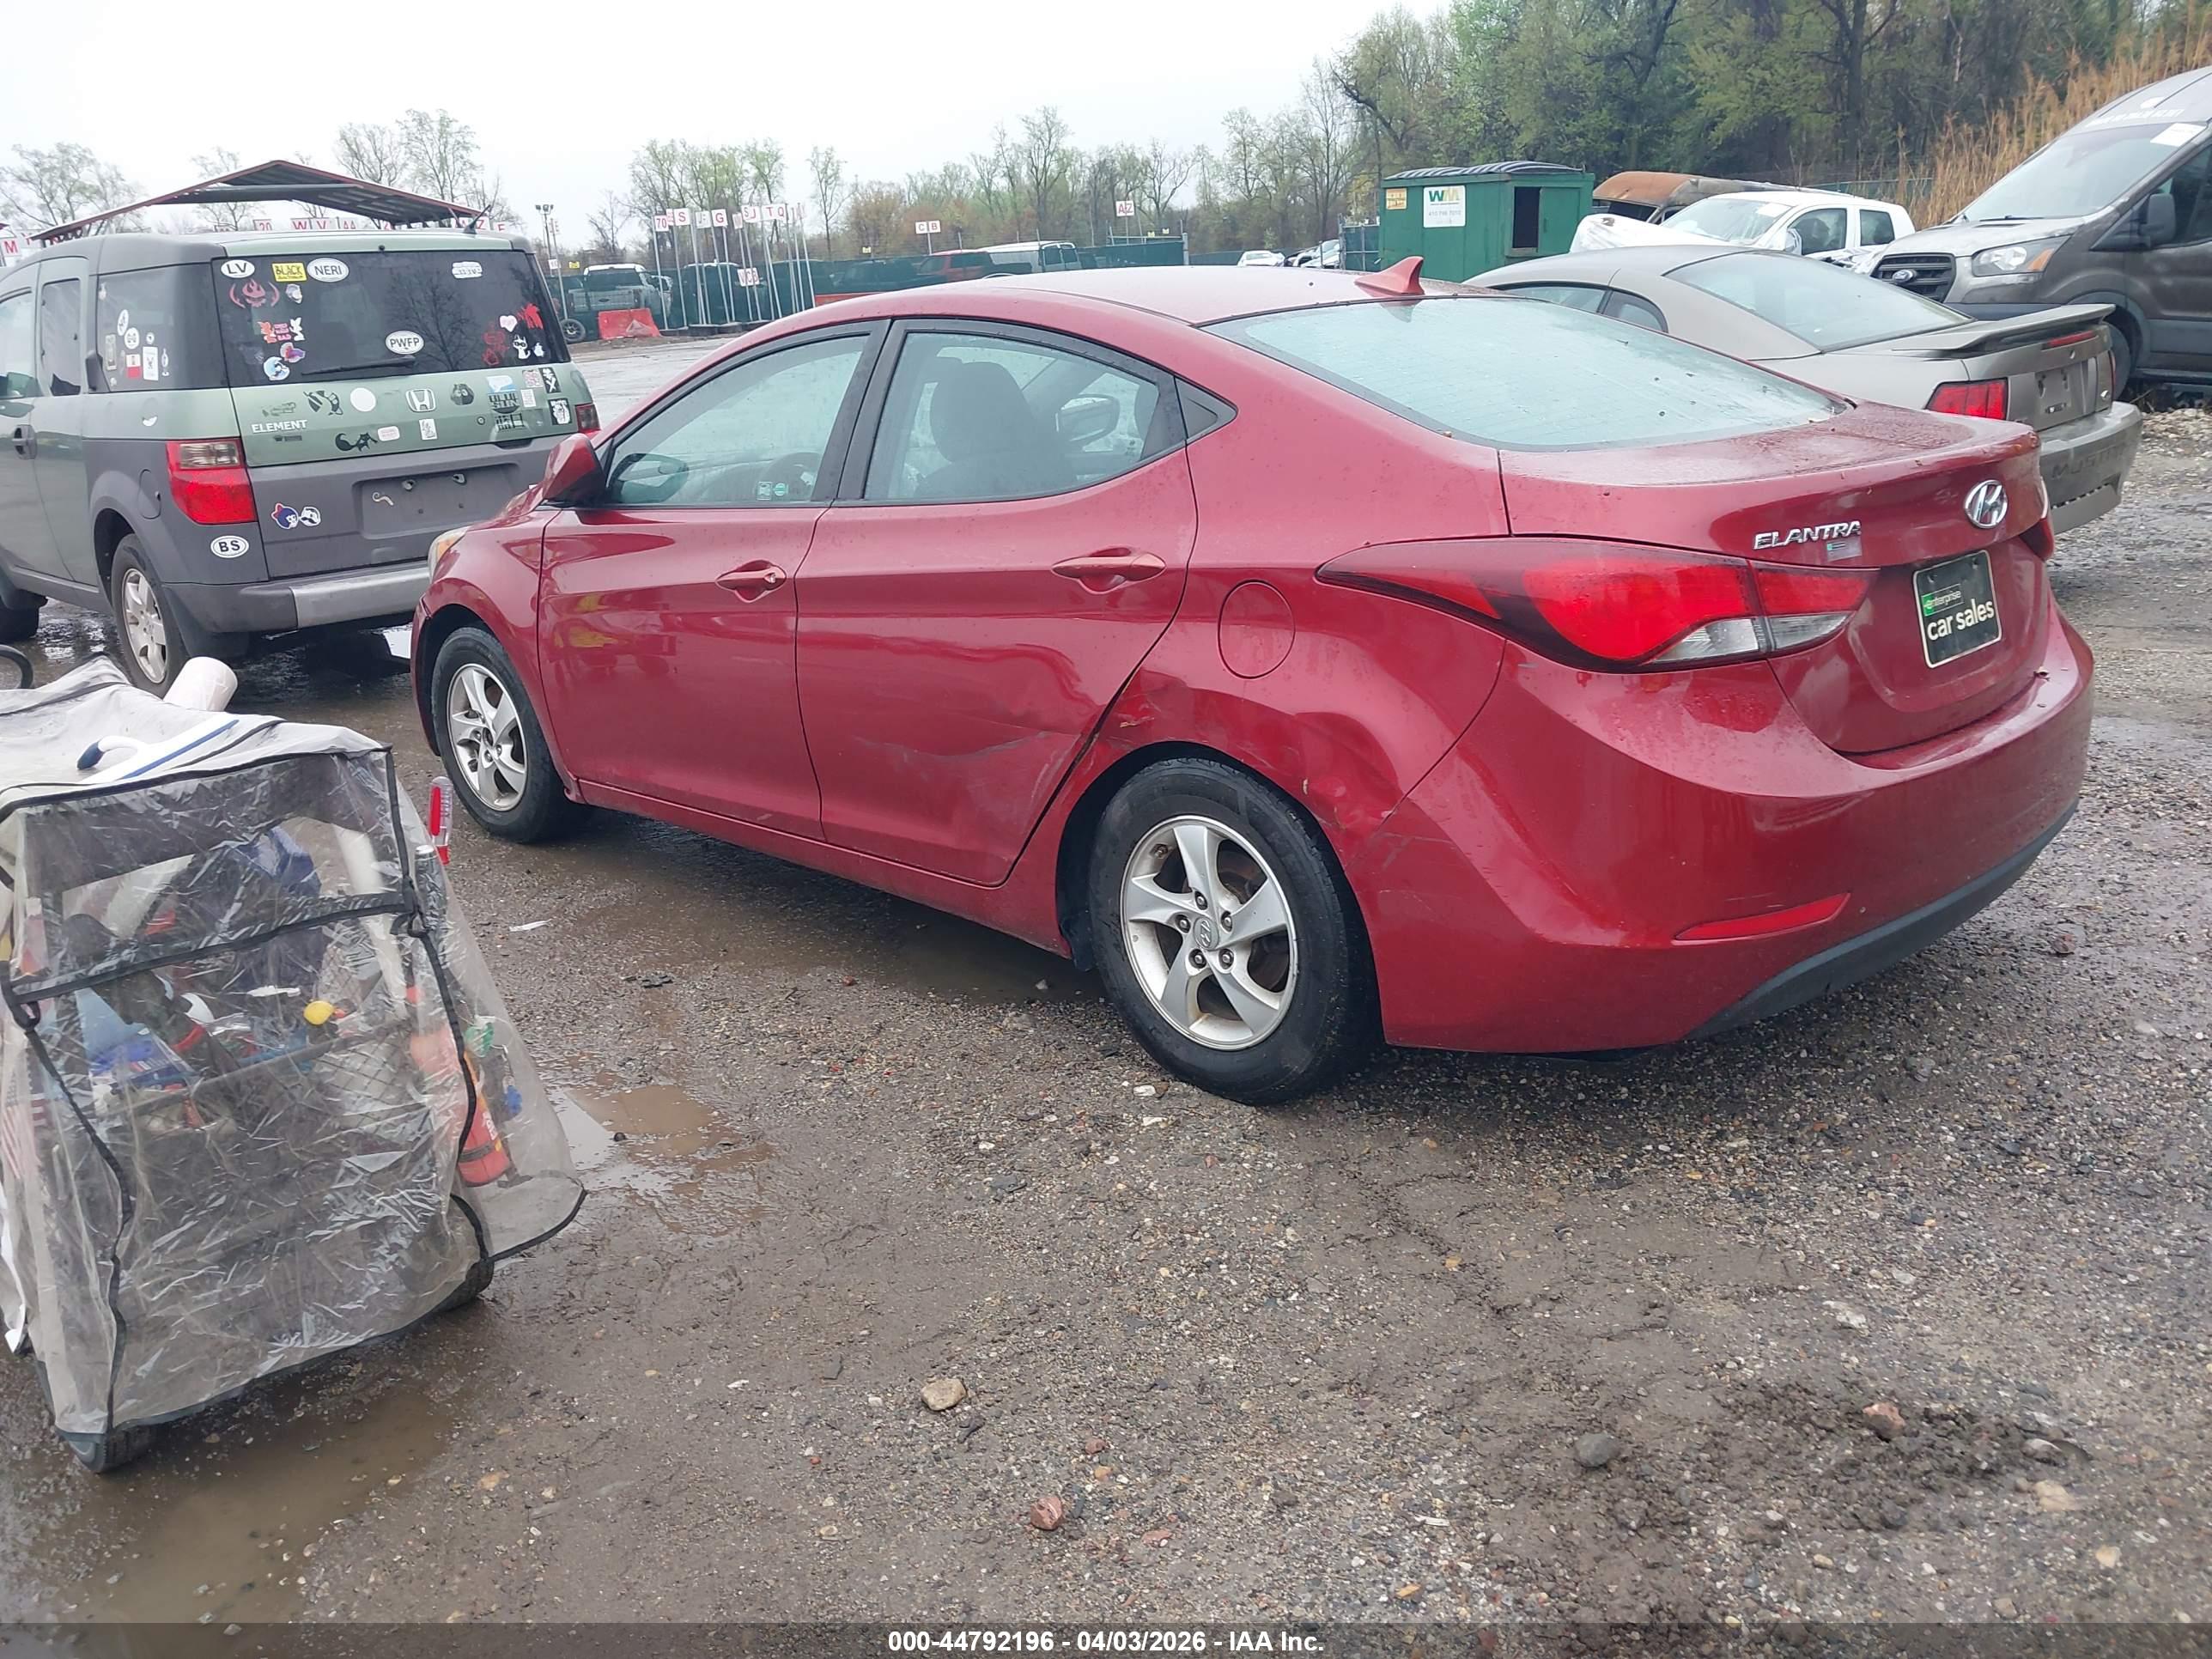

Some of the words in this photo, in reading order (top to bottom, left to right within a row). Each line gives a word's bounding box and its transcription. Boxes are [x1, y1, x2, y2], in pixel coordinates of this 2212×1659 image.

[678, 211, 686, 222] S
[715, 212, 724, 223] G
[656, 218, 667, 228] 70
[3, 240, 18, 254] M
[227, 262, 247, 275] LV
[314, 264, 343, 276] NERI
[389, 337, 421, 349] PWFP
[251, 419, 308, 434] ELEMENT
[1753, 520, 1862, 550] ELANTRA
[1927, 615, 1954, 641] car
[1955, 598, 1995, 630] sales
